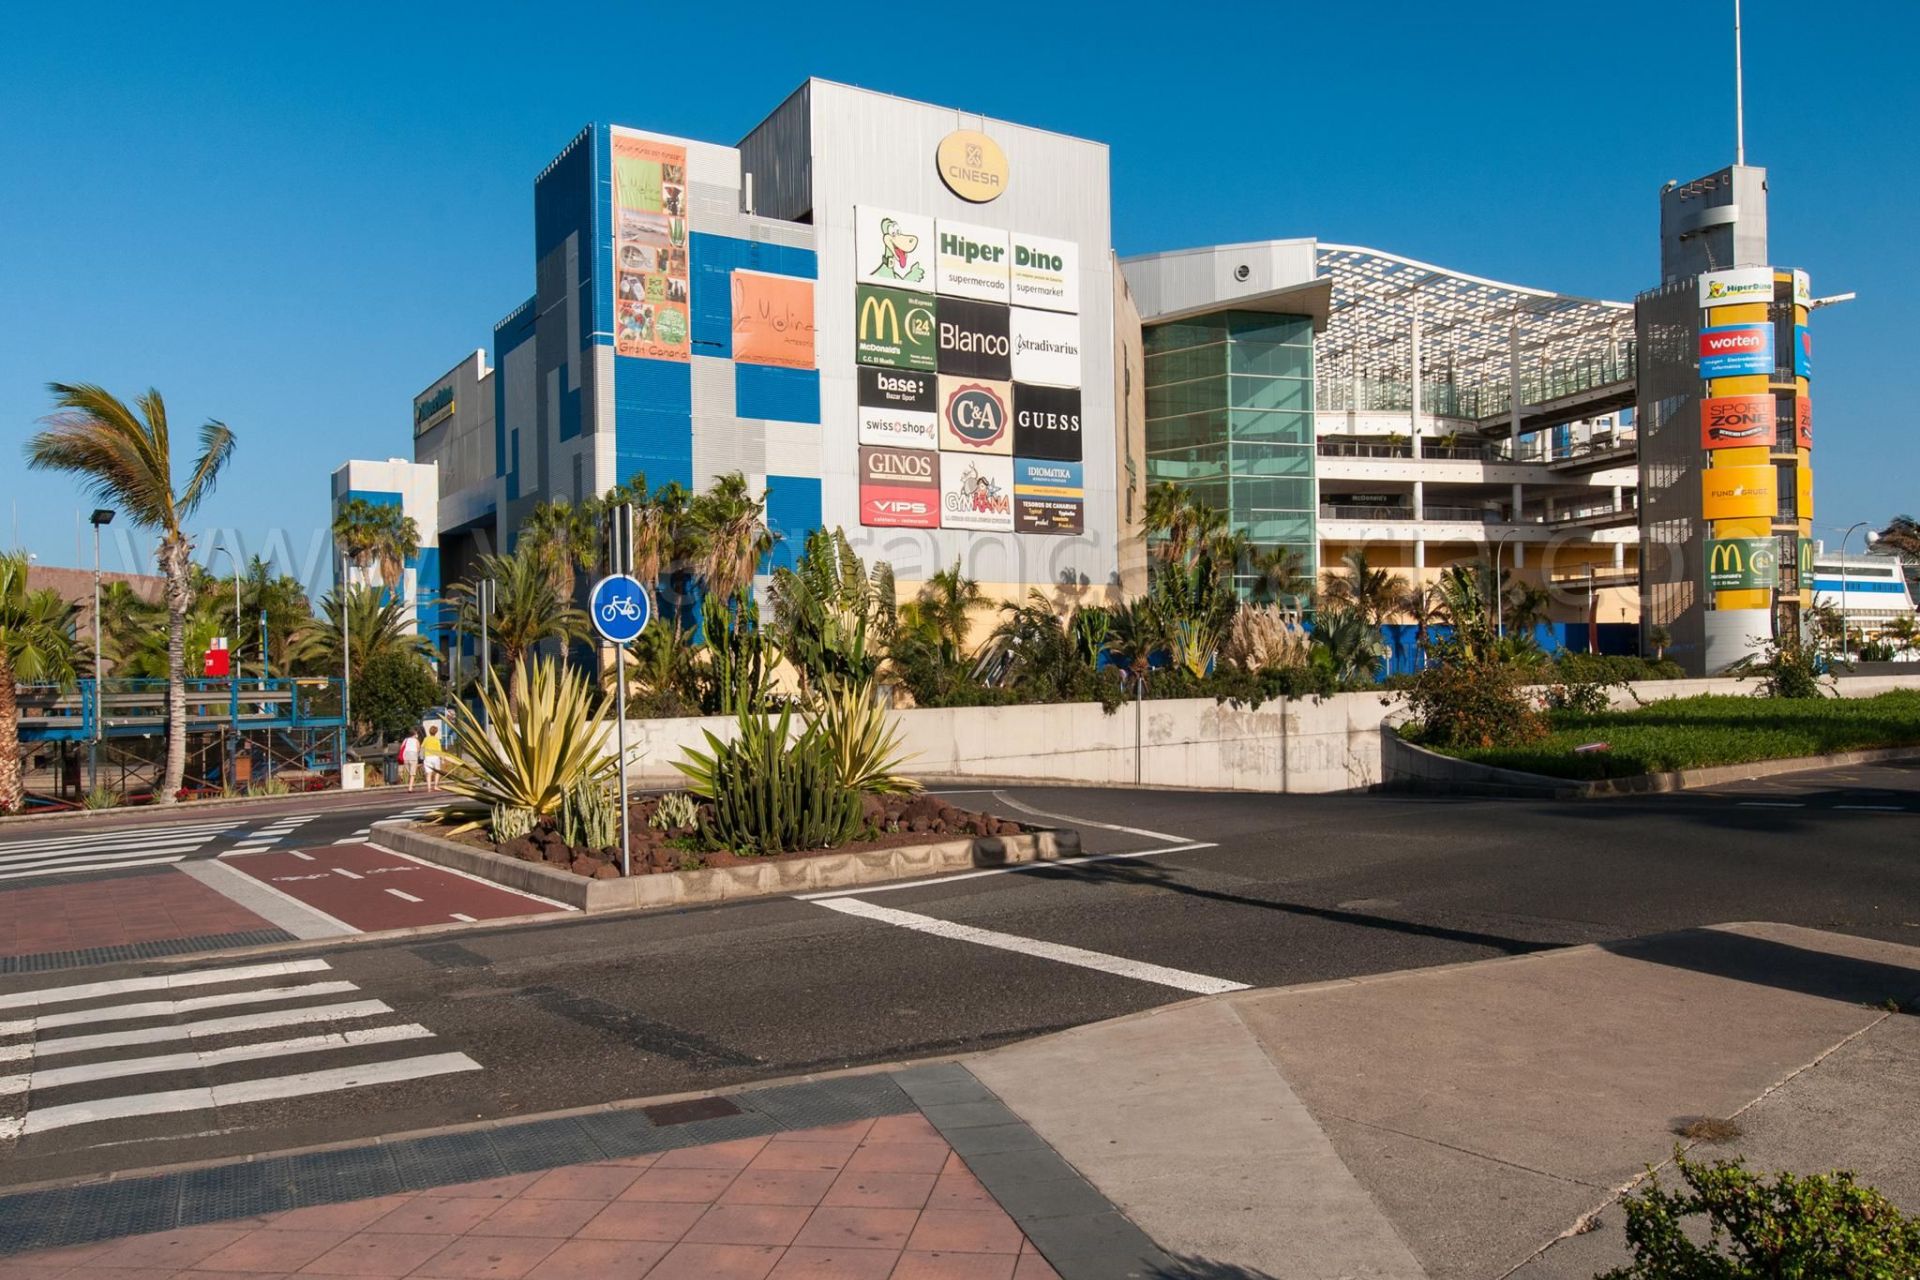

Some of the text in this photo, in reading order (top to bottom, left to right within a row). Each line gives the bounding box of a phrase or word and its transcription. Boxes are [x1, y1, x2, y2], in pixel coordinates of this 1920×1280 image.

[949, 165, 1000, 187] CINESA
[941, 232, 1063, 272] Hiper Dino
[949, 273, 1005, 290] supermercado
[1727, 283, 1772, 292] HiperDino
[1016, 283, 1064, 297] supermarket
[915, 319, 930, 332] 24
[940, 322, 1010, 356] Blanco
[1709, 336, 1760, 350] worten
[860, 342, 901, 355] McDonald's
[957, 400, 997, 431] C&A
[1710, 402, 1768, 416] SPORT
[1018, 410, 1080, 431] GUESS
[1710, 414, 1767, 427] ZONE
[868, 453, 932, 476] GINOS
[873, 500, 928, 514] VIPS
